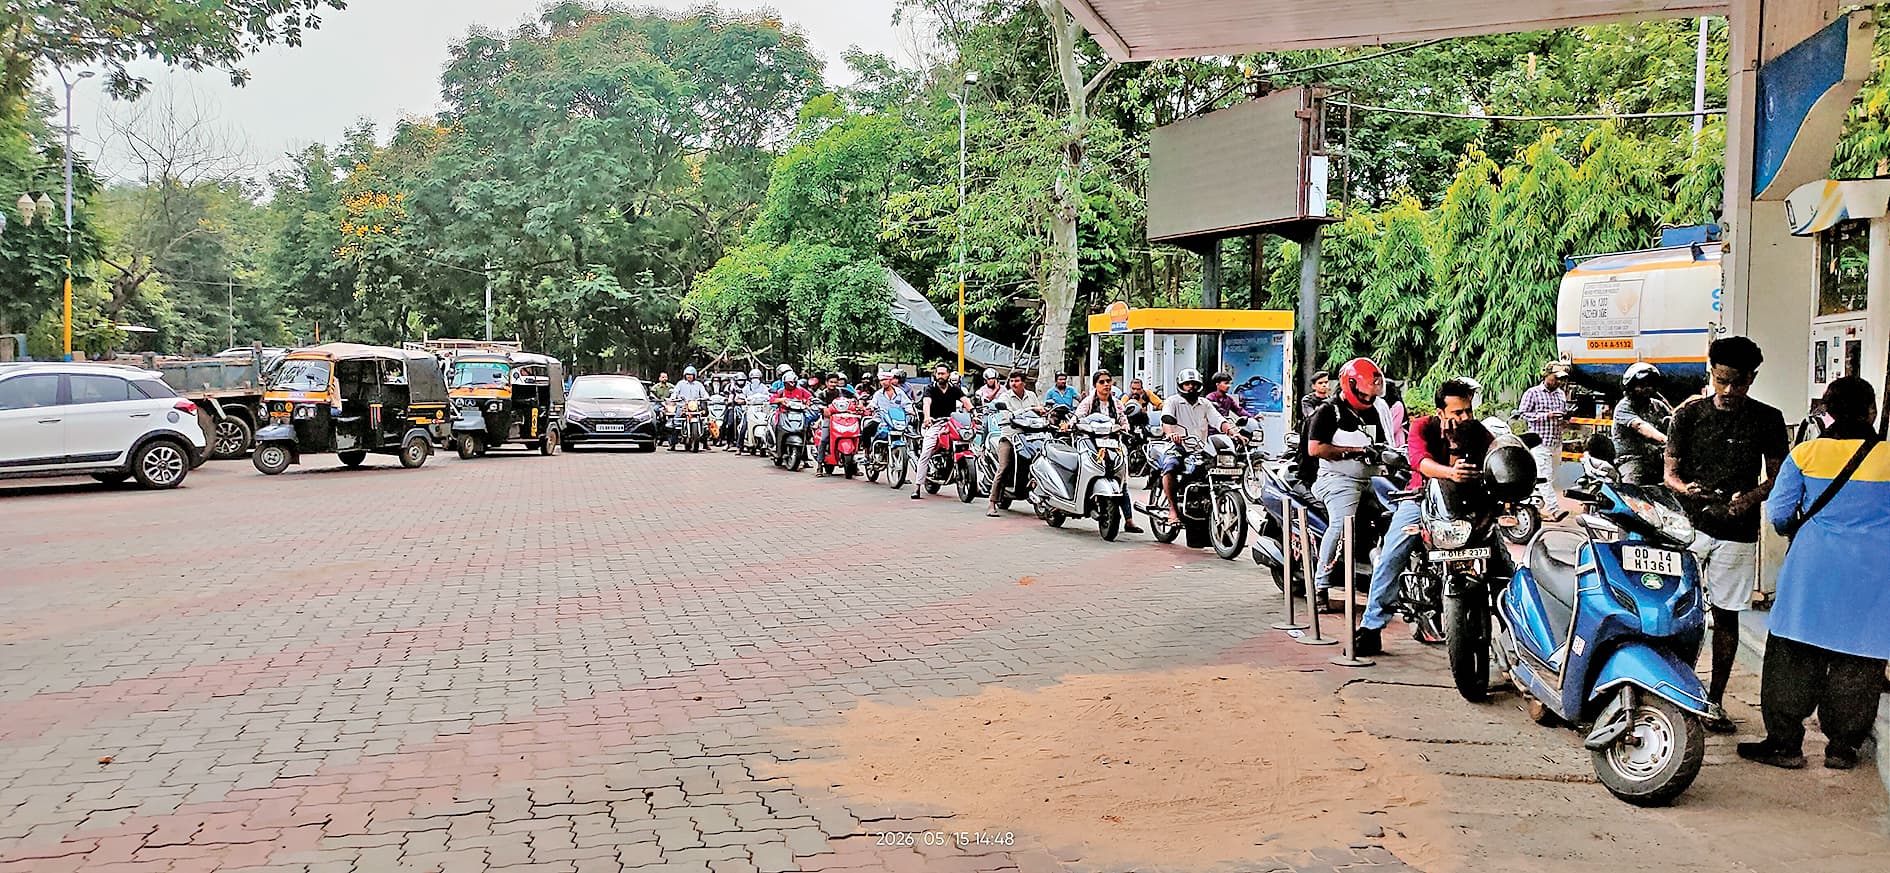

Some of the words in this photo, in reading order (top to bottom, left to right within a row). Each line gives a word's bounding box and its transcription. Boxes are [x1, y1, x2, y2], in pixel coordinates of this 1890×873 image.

[1635, 548, 1648, 559] OD
[1658, 551, 1672, 562] 14
[1635, 559, 1672, 573] H1361
